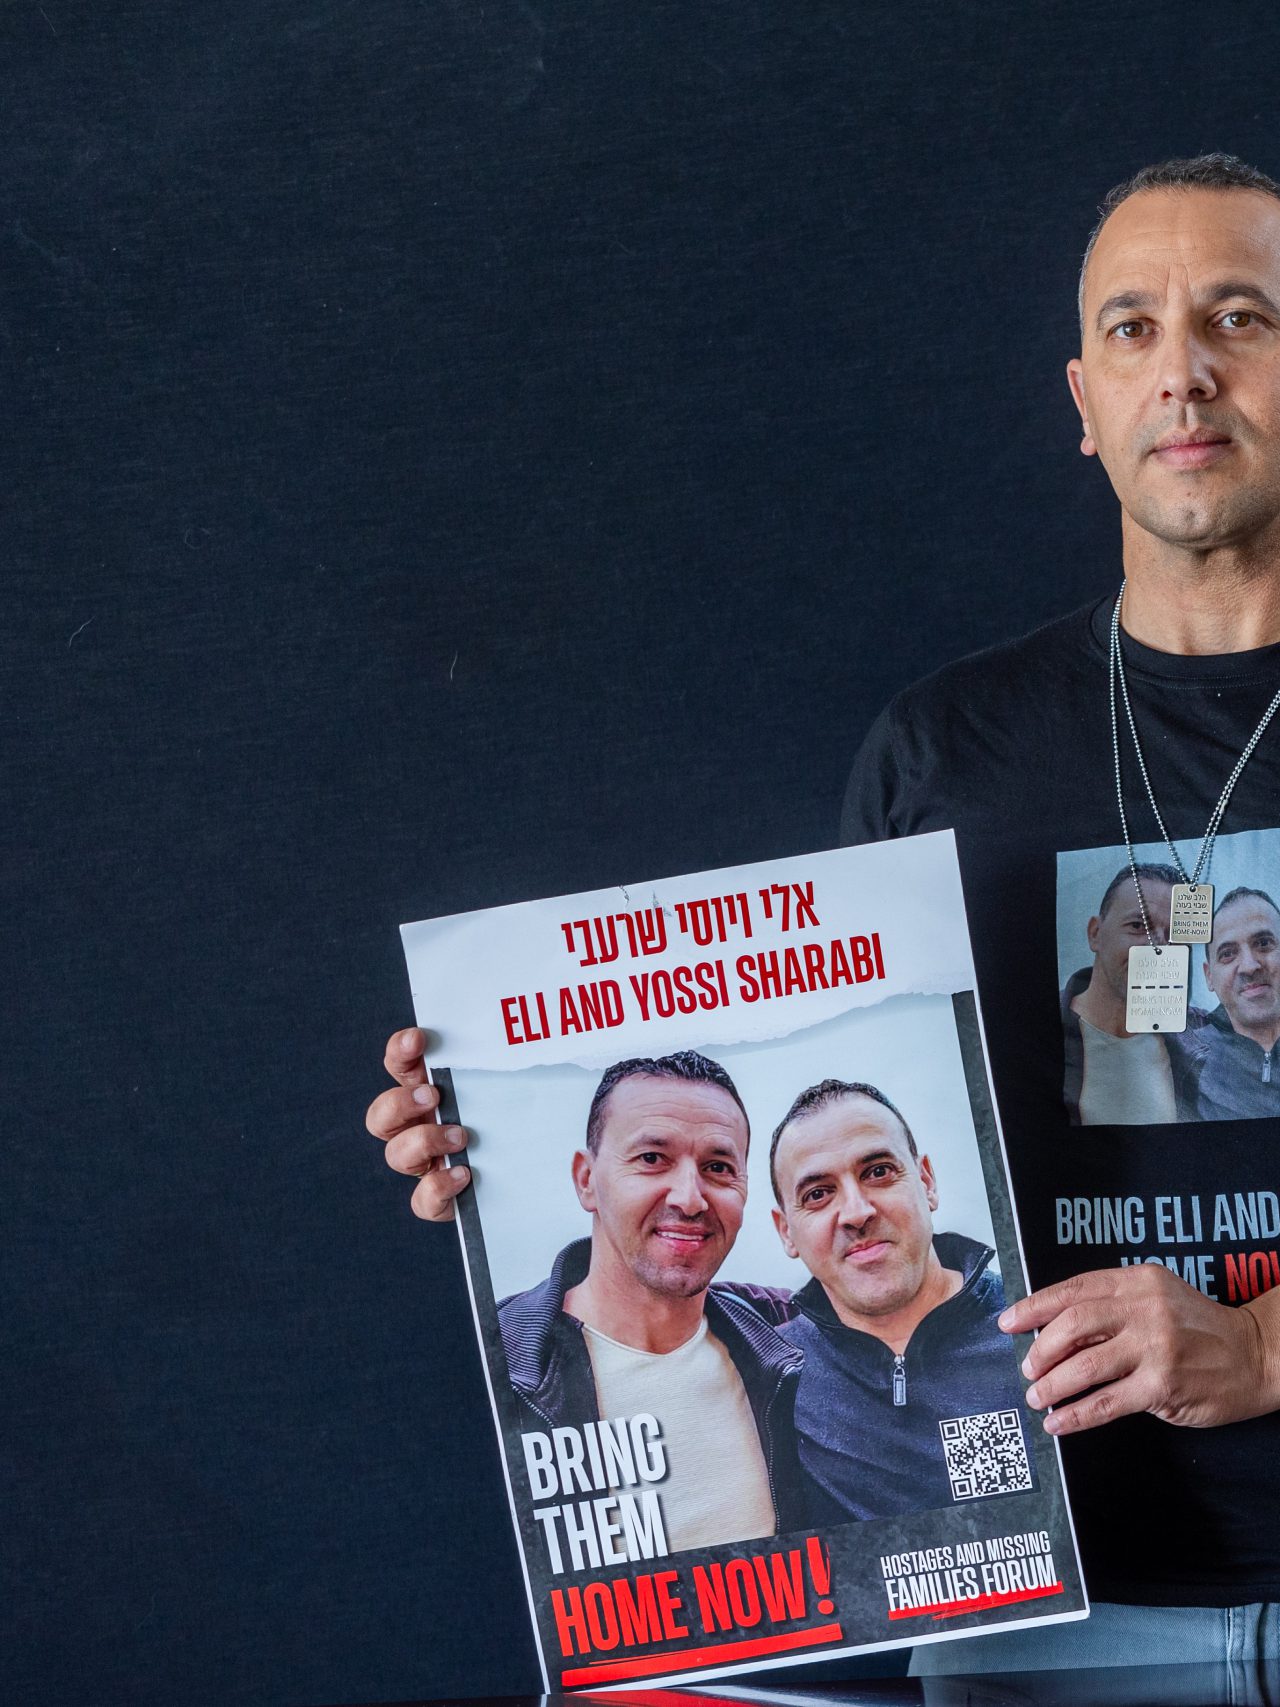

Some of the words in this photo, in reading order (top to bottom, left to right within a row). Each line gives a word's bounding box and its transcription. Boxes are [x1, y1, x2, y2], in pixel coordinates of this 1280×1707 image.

[673, 892, 754, 946] ויוסי
[758, 880, 821, 932] אלי
[560, 907, 668, 967] שרעבי
[500, 992, 551, 1046] ELI
[559, 980, 625, 1036] AND
[628, 959, 731, 1022] YOSSI
[735, 932, 886, 1003] SHARABI
[1055, 1196, 1146, 1245] BRING
[1154, 1195, 1203, 1243] ELI
[521, 1413, 666, 1500] BRING
[533, 1489, 669, 1575] THEM
[880, 1546, 954, 1578] HOSTAGES
[956, 1541, 985, 1567] AND
[985, 1530, 1051, 1562] MISSING
[551, 1570, 689, 1657] HOME
[692, 1536, 835, 1634] NOW!
[884, 1566, 980, 1612] FAMILIES
[981, 1554, 1058, 1597] FORUM
